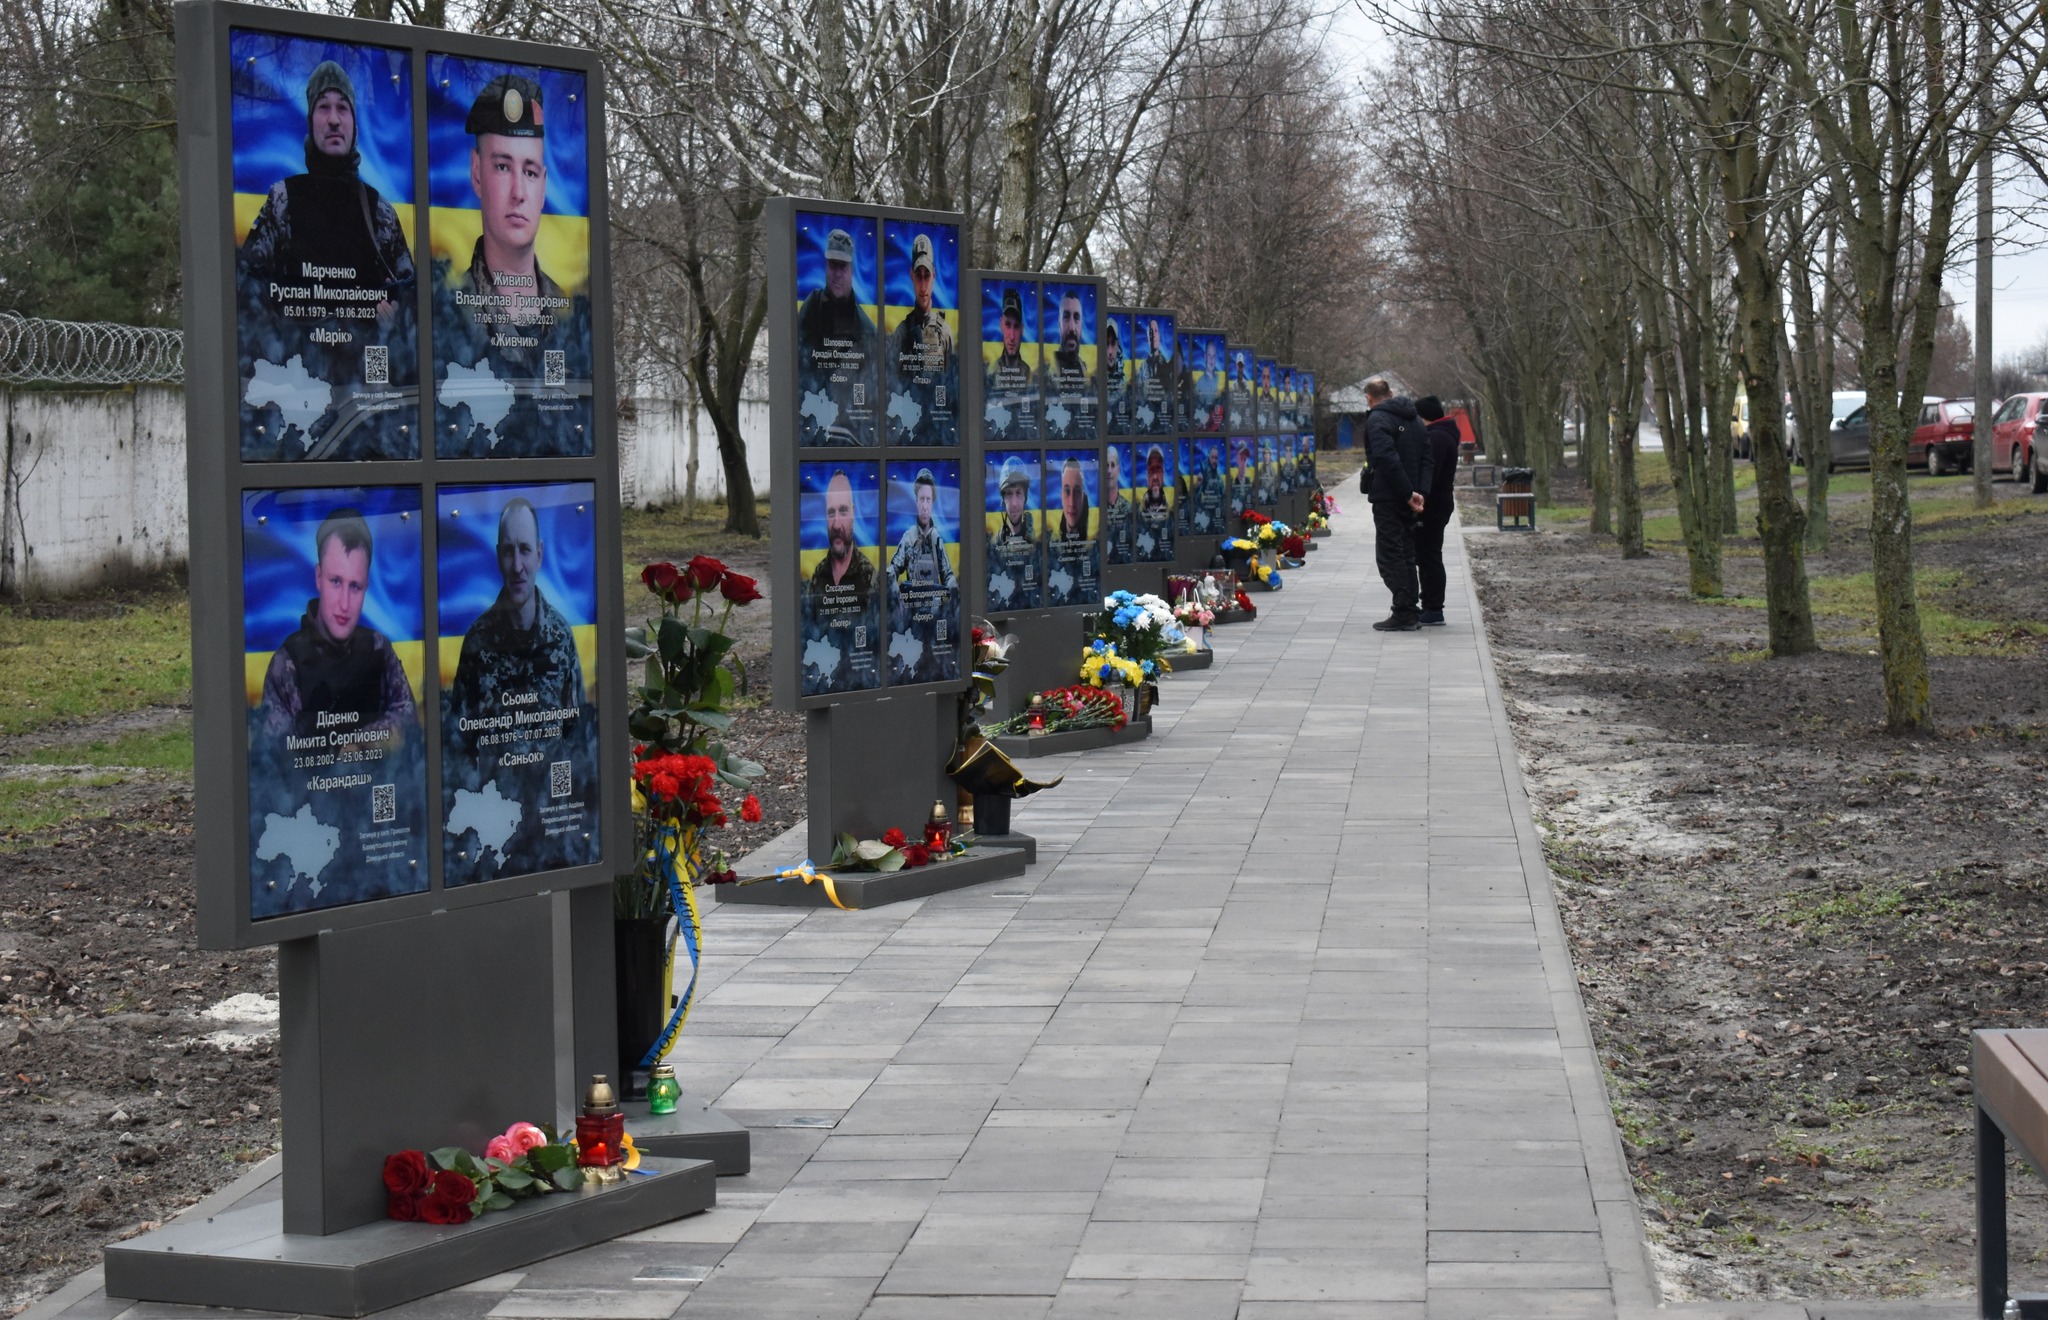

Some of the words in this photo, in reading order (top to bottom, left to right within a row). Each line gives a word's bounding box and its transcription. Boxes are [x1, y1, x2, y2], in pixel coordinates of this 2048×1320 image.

[302, 262, 357, 281] Марченко
[493, 271, 533, 287] Живило
[270, 282, 311, 302] Руслан
[313, 284, 388, 301] Миколайович
[455, 290, 512, 308] Владислав
[513, 293, 570, 310] Григорович
[284, 306, 326, 318] 05.01.1979
[335, 307, 376, 319] 19.06.2023
[473, 313, 511, 324] 17.06.1997
[309, 327, 353, 346] «Марік»
[490, 333, 539, 347] «Живчик»
[823, 337, 854, 347] Шаповалов
[811, 349, 833, 360] Аркадій
[899, 352, 918, 362] Дмитро
[822, 596, 835, 605] Олег
[836, 595, 858, 605] Ігорович
[501, 691, 539, 706] Сьомак
[316, 710, 359, 729] Діденко
[459, 715, 513, 731] Олександр
[515, 707, 580, 725] Миколайович
[286, 735, 327, 751] Микита
[329, 729, 390, 747] Сергійович
[480, 732, 517, 746] 06.08.1976
[524, 726, 560, 740] 07.07.2023
[294, 754, 335, 769] 23.08.2002
[343, 748, 383, 763] 25.06.2023
[498, 752, 544, 767] «Саньок»
[306, 773, 372, 792] «Карандаш»
